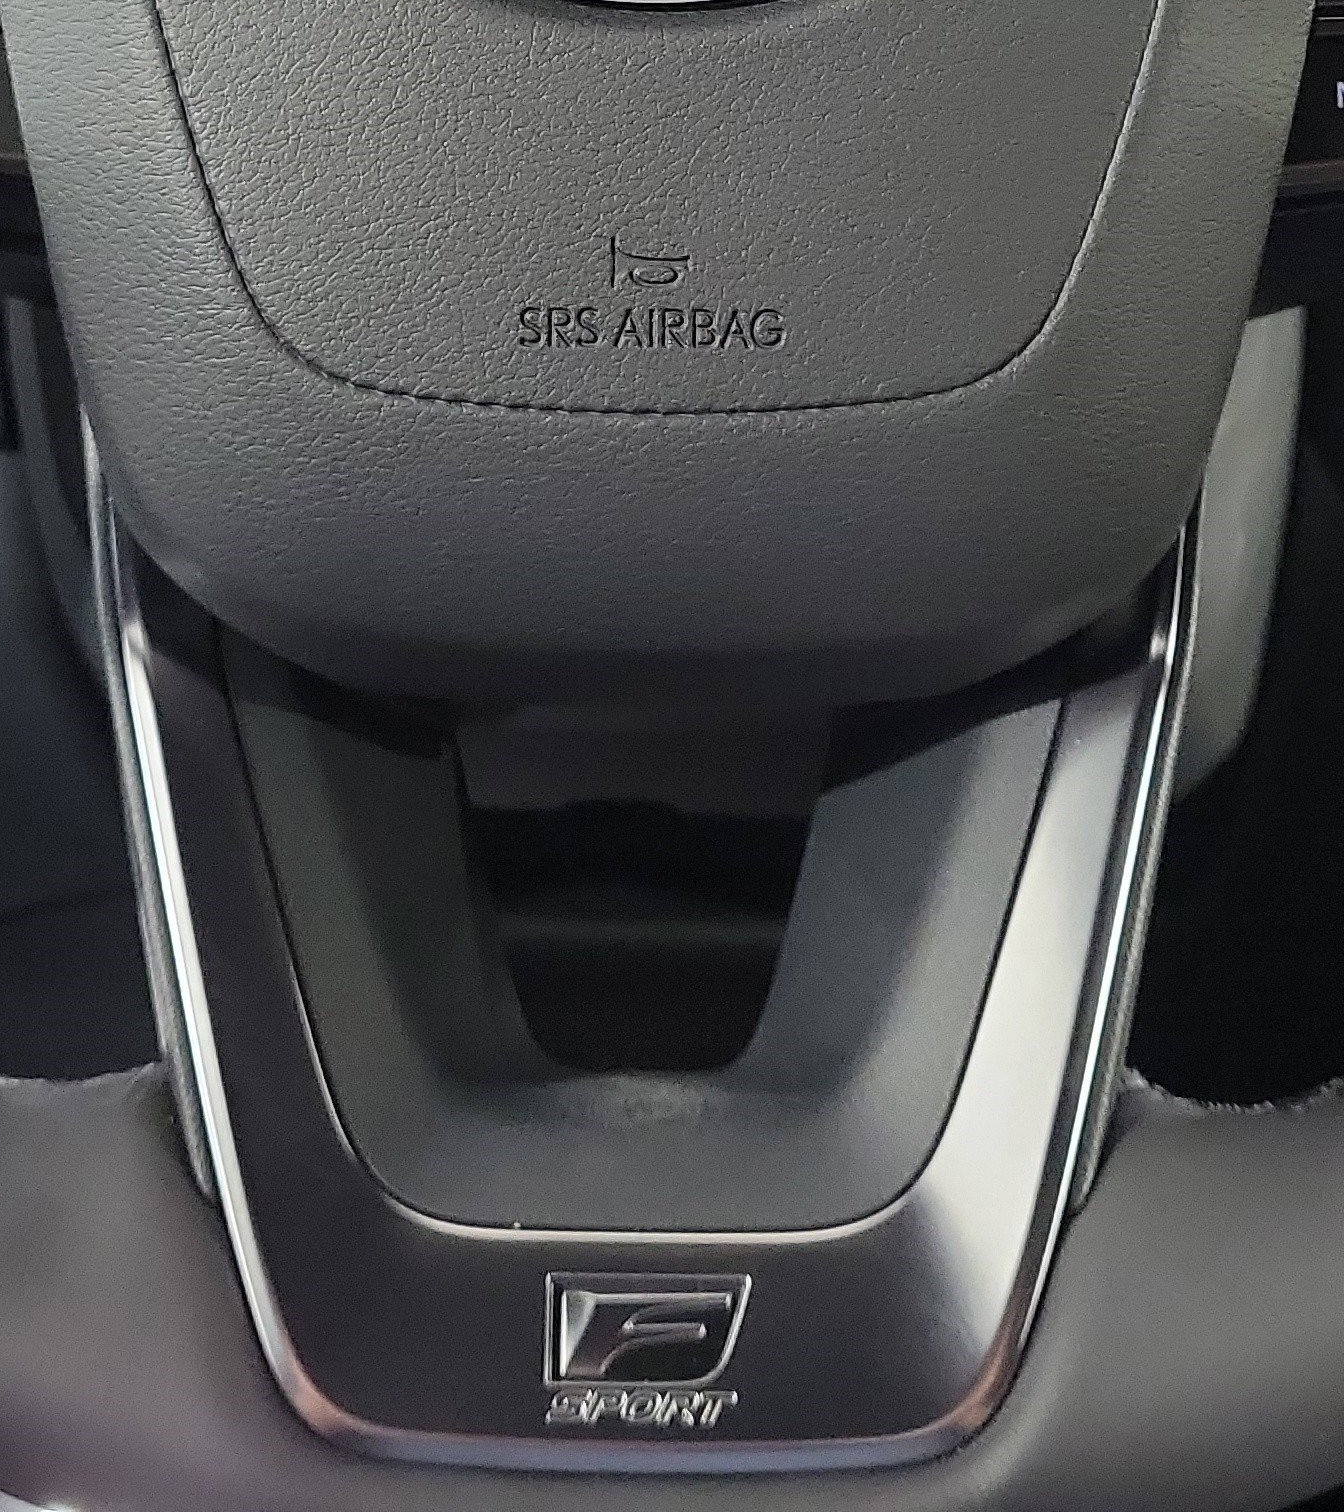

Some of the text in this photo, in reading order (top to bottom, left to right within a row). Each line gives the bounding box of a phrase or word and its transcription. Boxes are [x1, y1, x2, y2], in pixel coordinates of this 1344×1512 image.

[517, 308, 786, 348] SRS AIRBAG
[544, 1388, 739, 1428] SPORT
